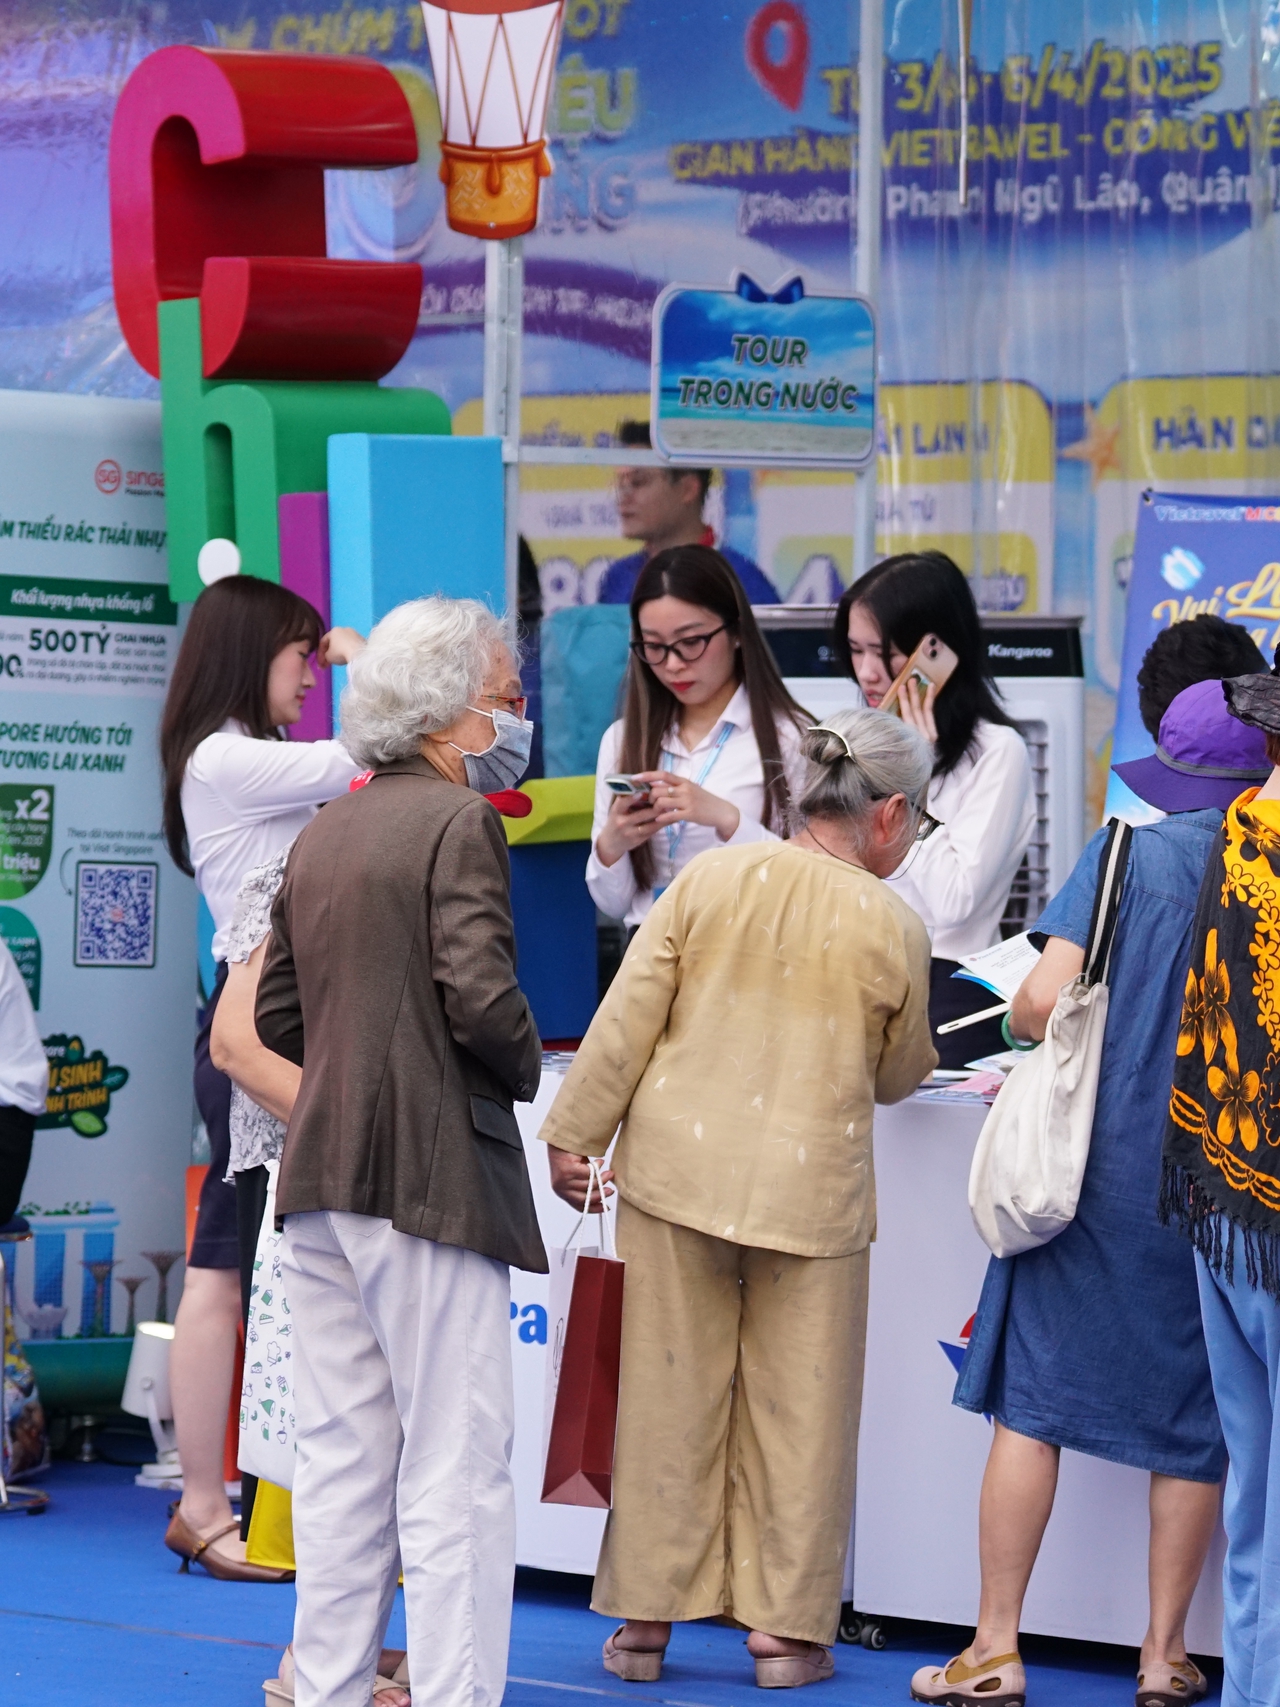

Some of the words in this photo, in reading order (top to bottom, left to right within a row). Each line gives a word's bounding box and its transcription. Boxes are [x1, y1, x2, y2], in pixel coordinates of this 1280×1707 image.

[732, 334, 809, 367] TOUR
[678, 376, 777, 411] TRONG
[779, 375, 860, 412] NƯỚC
[63, 519, 95, 544] RÁC
[98, 521, 132, 547] THẢI
[135, 530, 166, 553] NHỰ
[987, 643, 1054, 661] Kangaroo
[0, 721, 39, 743] PORE
[43, 720, 102, 746] HƯỚNG
[106, 720, 134, 747] TỚI
[0, 750, 50, 771] ƯƠNG
[52, 751, 78, 771] LAI
[79, 753, 126, 773] XANH
[15, 788, 50, 821] x2
[3, 852, 41, 874] triệu
[59, 1060, 104, 1088] SINH
[67, 1086, 109, 1111] TRÌNH
